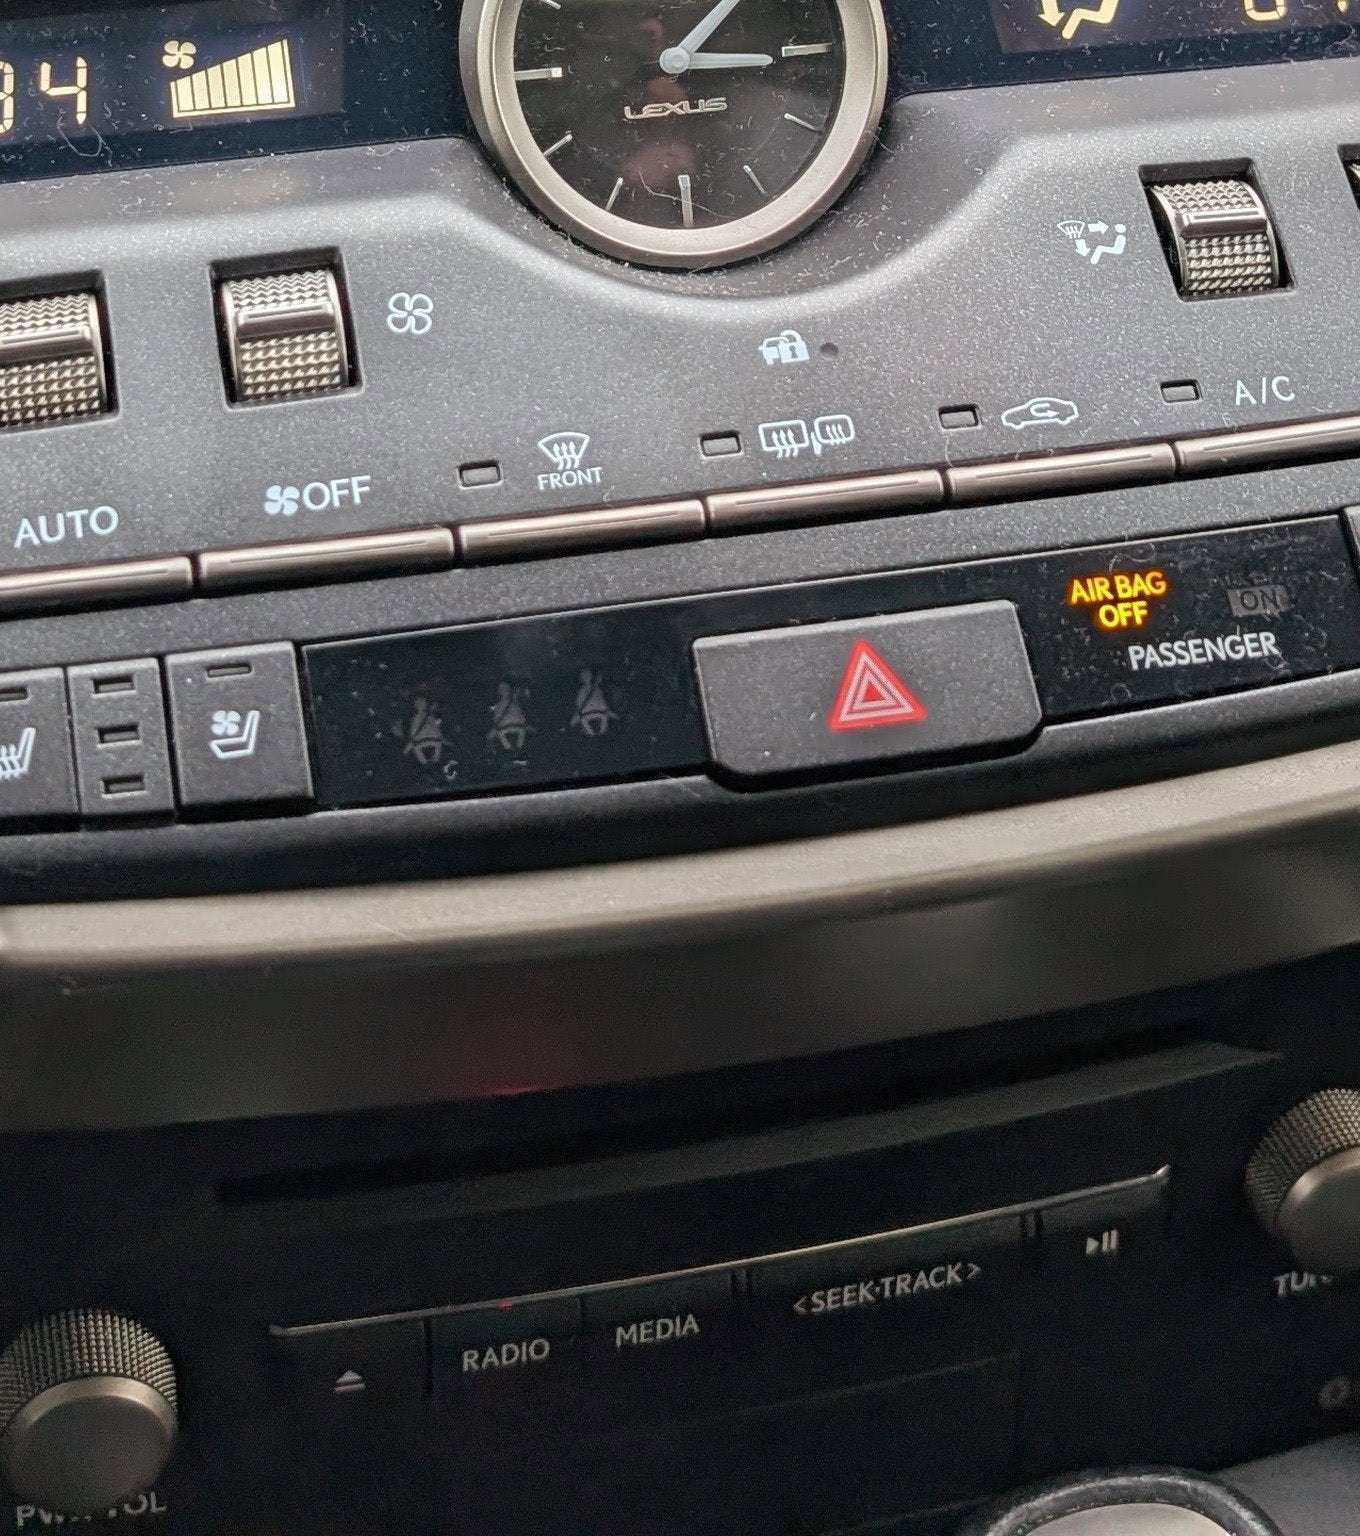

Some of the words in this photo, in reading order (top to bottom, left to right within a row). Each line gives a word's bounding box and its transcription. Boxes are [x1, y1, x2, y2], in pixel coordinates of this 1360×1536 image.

[623, 96, 729, 120] LEXUS
[1235, 374, 1296, 406] A/C
[301, 474, 372, 513] OFF
[538, 465, 603, 491] FRONT
[13, 505, 120, 550] AUTO
[1068, 574, 1116, 605] AIR
[1114, 570, 1168, 598] BAG
[1240, 588, 1281, 612] ON
[1098, 600, 1149, 629] OFF
[1127, 630, 1282, 672] PASSENGER
[615, 1313, 701, 1349] MEDIA
[461, 1338, 551, 1373] RADIO
